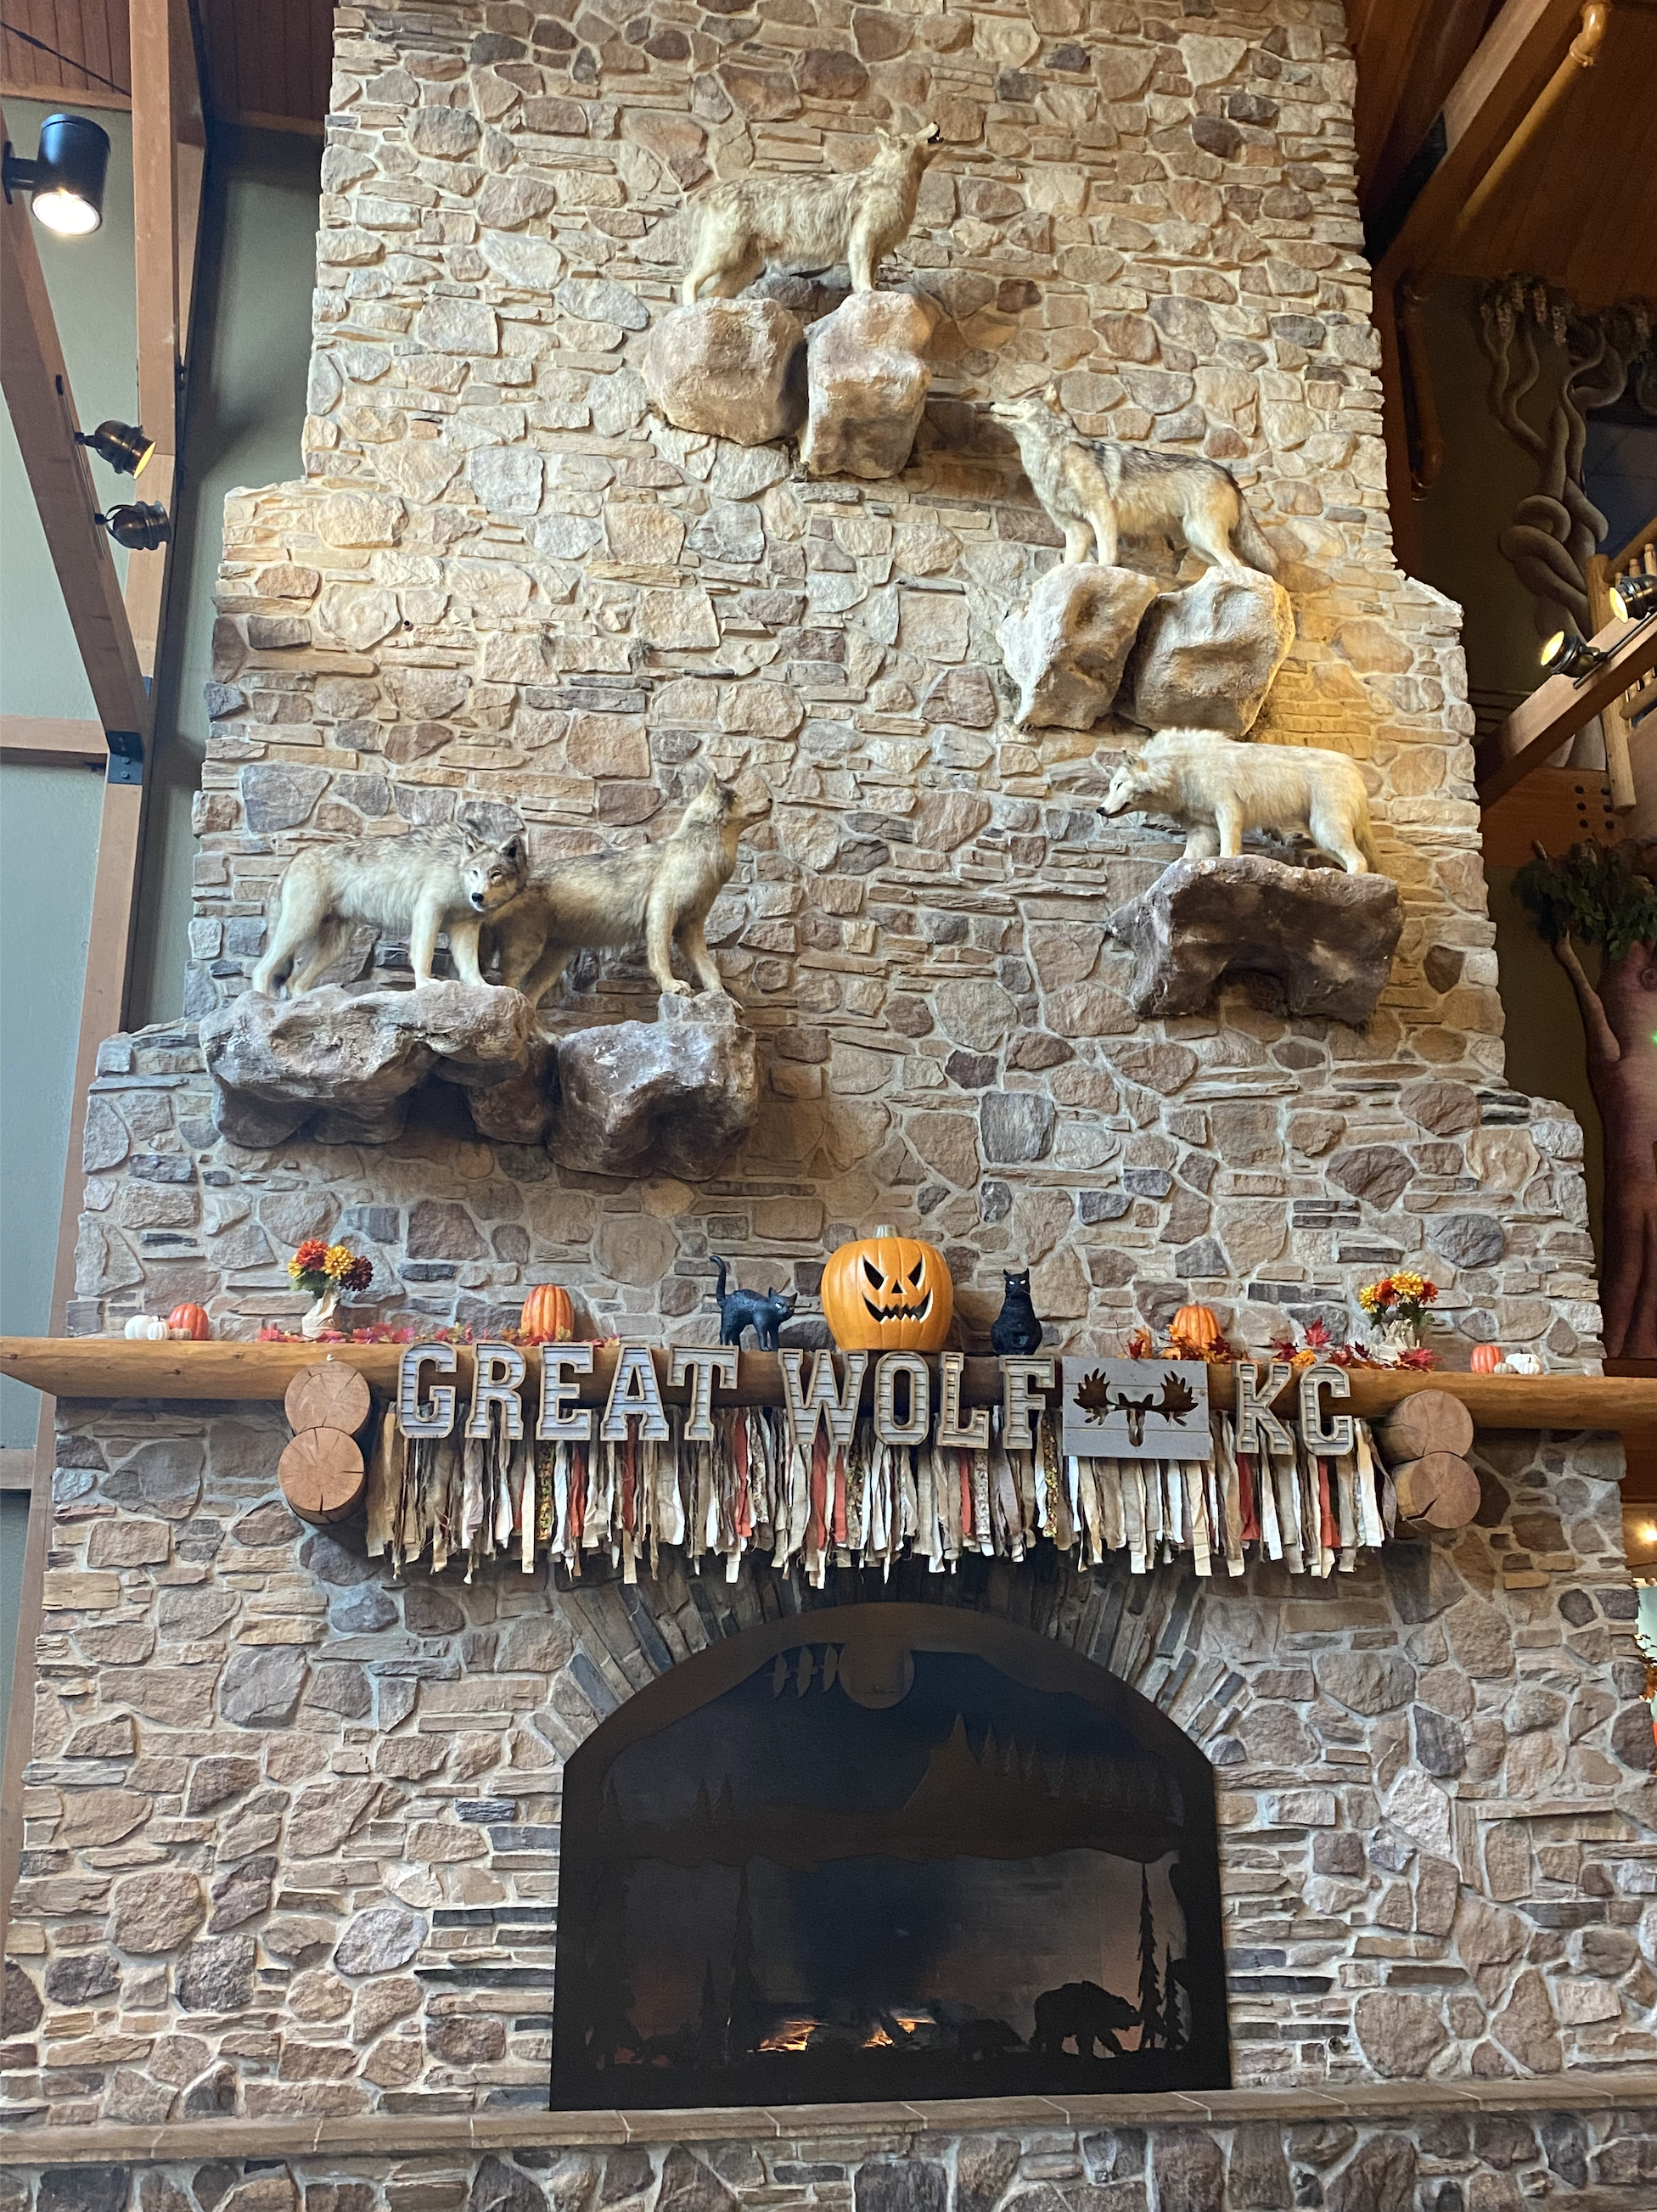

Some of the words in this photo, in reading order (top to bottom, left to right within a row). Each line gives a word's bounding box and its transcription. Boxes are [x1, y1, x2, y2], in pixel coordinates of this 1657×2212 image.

[397, 1341, 739, 1441] GREAT
[778, 1348, 1056, 1450] WOLF
[1234, 1361, 1354, 1456] KC
